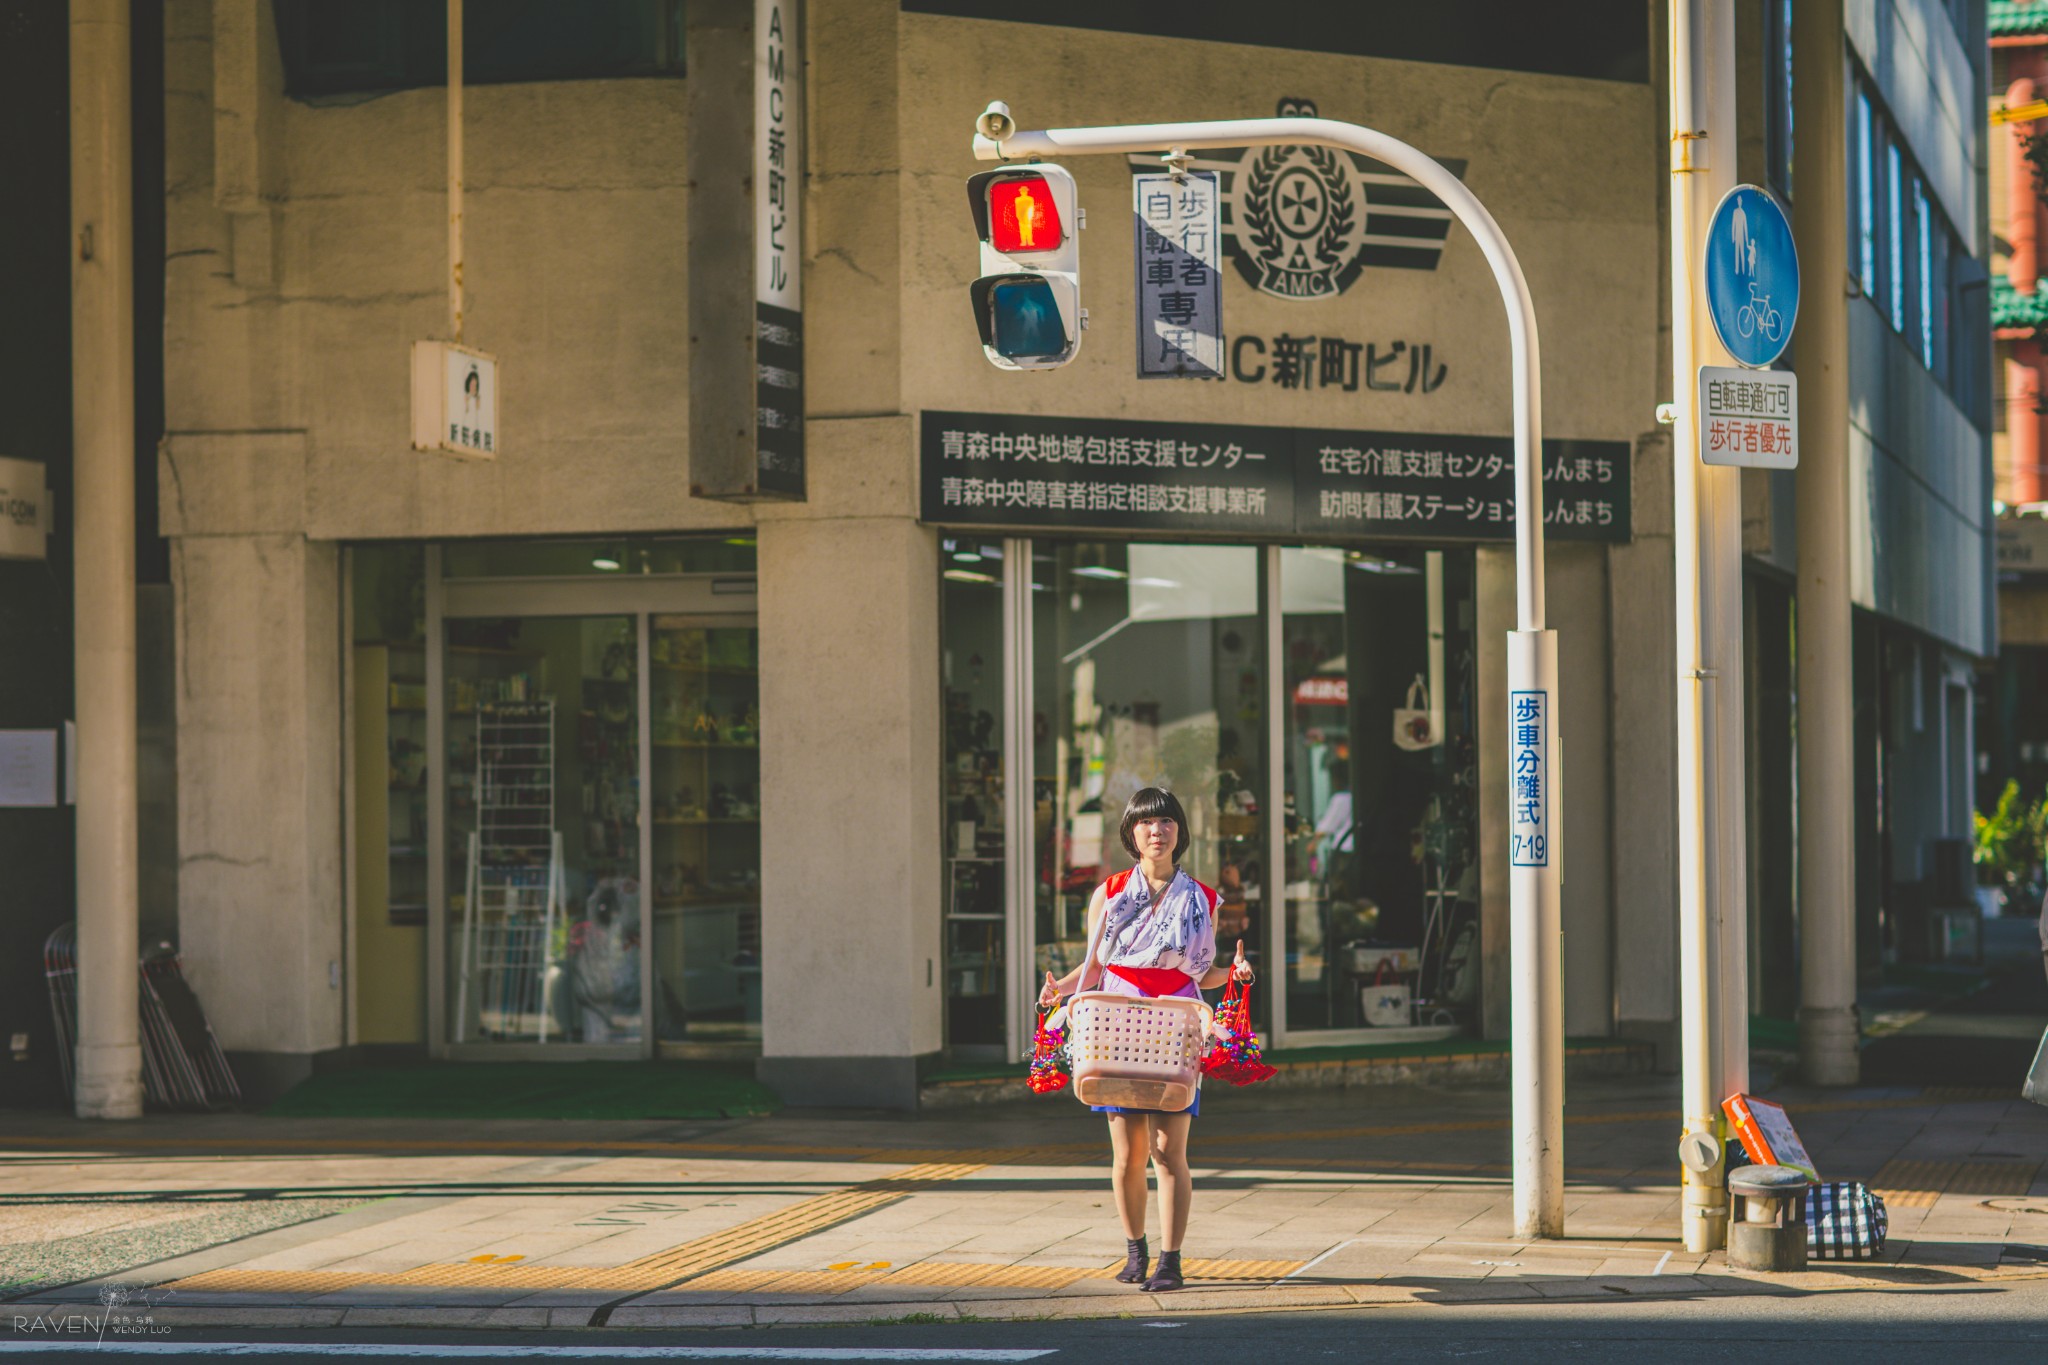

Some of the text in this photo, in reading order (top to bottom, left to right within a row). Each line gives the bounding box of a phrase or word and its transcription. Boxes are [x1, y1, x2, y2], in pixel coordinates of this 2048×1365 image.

[768, 6, 787, 291] AMC新町ビル
[1145, 191, 1175, 288] 自転車
[1178, 189, 1209, 287] 歩行者
[1273, 271, 1325, 296] AMC
[1158, 291, 1198, 363] 専用
[1222, 333, 1448, 394] C新町ビル
[1709, 379, 1790, 414] 自転車通行可
[941, 430, 1266, 469] 青森中央地域包括支援センター
[1710, 419, 1792, 455] 歩行者優先
[941, 476, 1266, 516] 青森中央障害者指定相談支援事業所
[1516, 697, 1540, 826] 歩車分離式
[1514, 834, 1545, 860] 7-19
